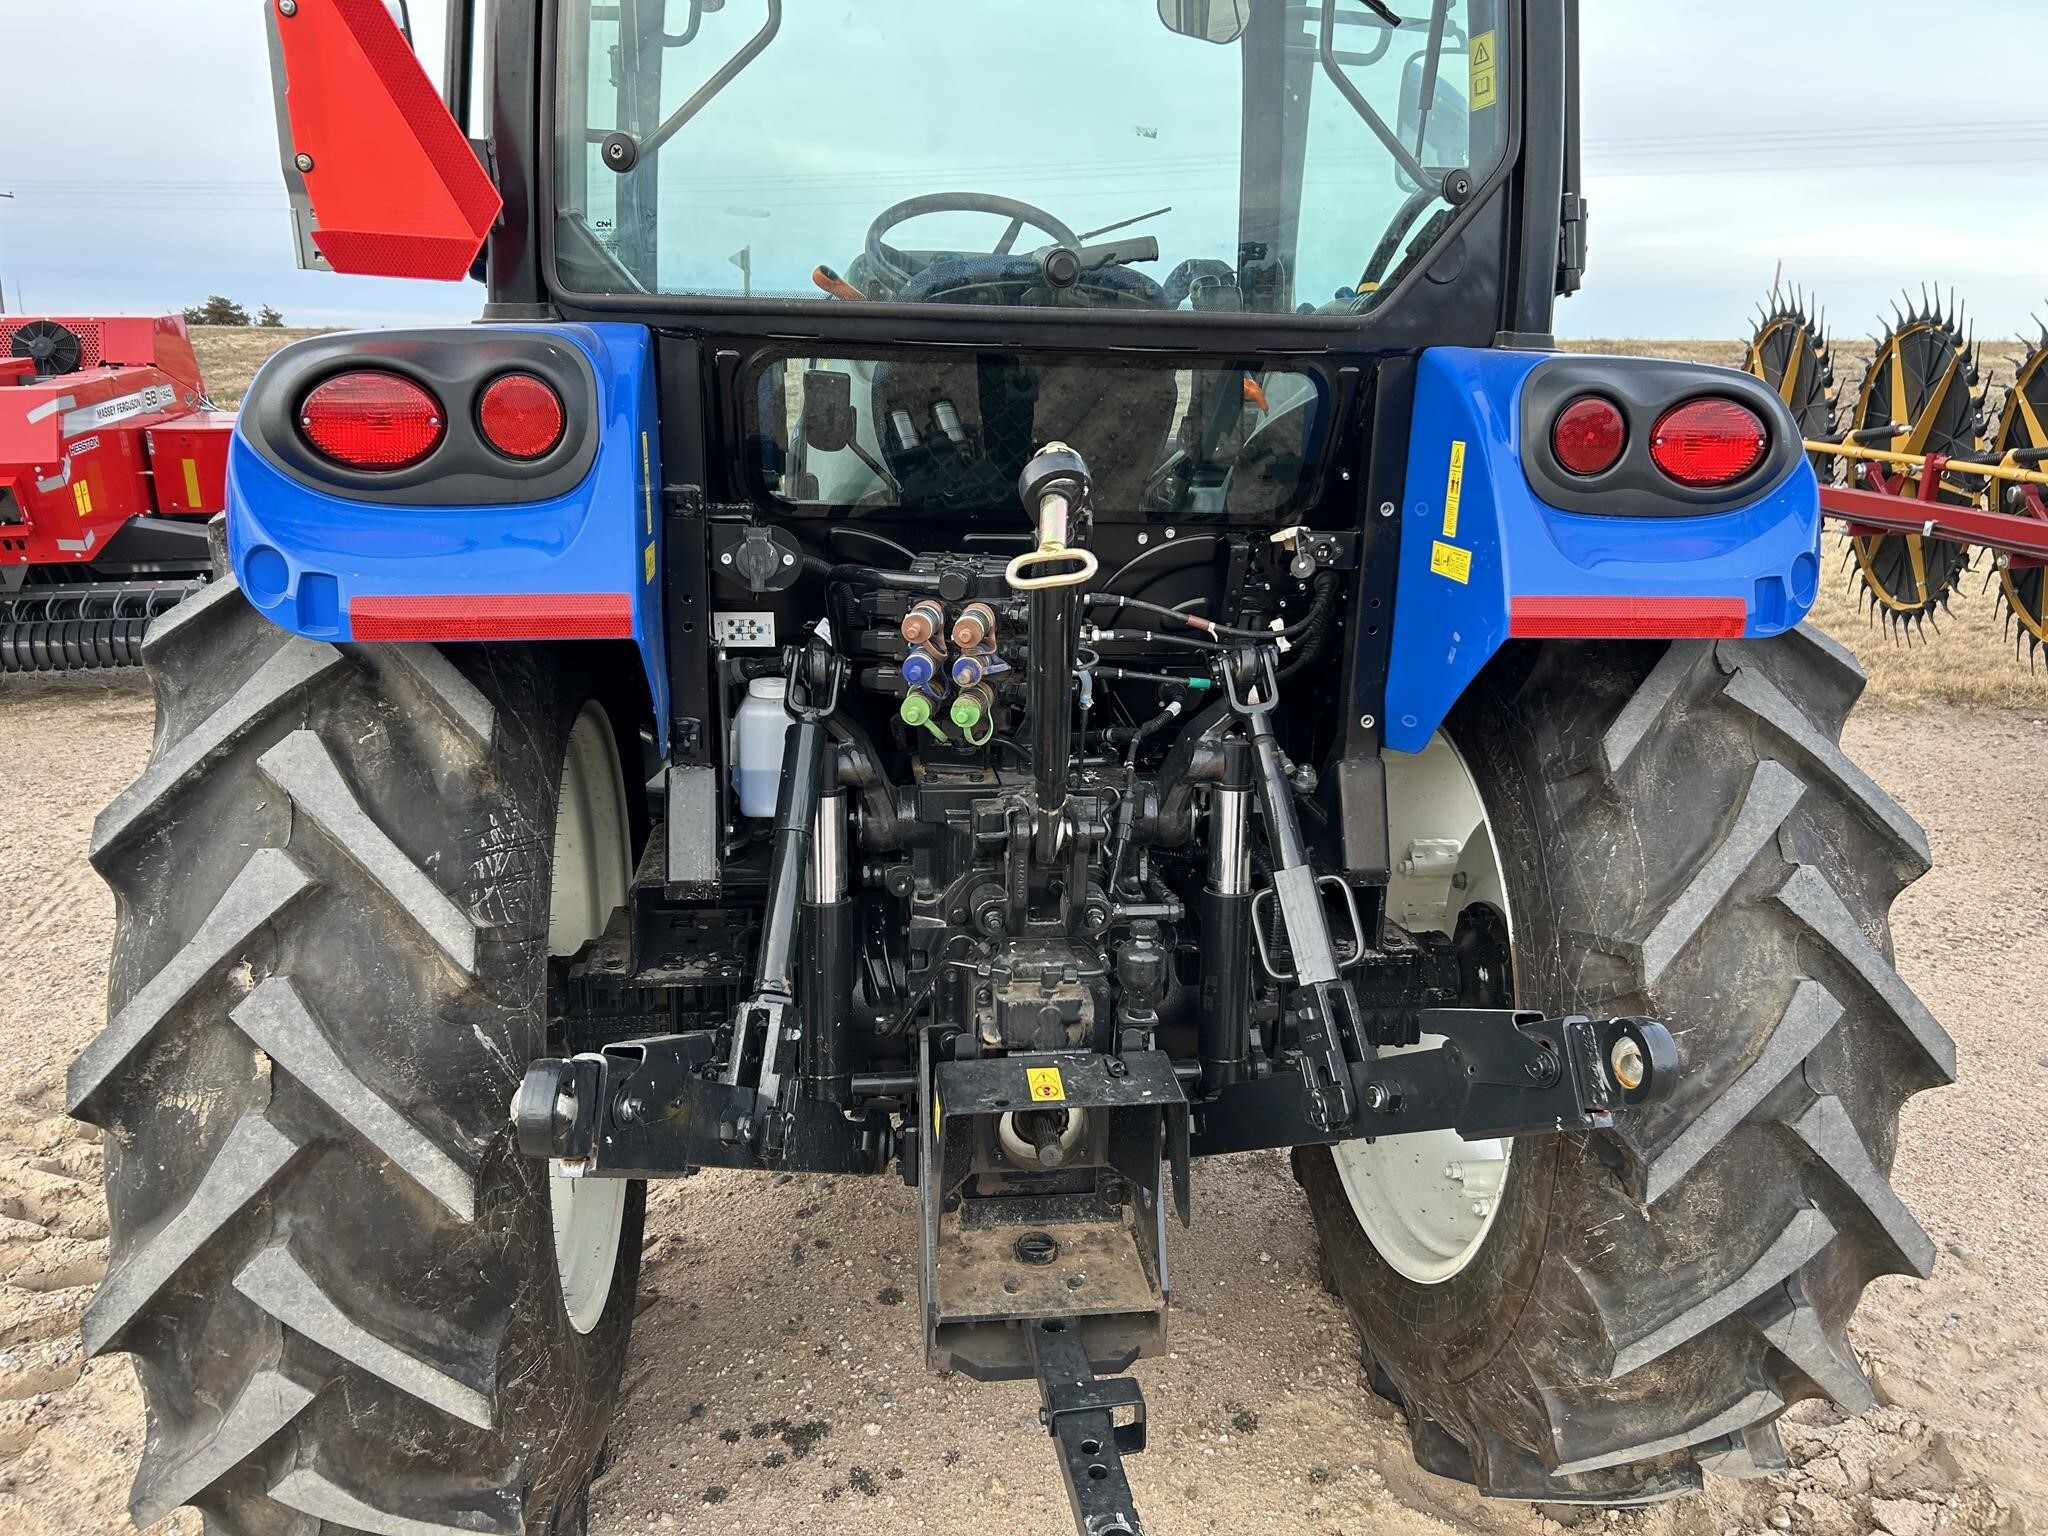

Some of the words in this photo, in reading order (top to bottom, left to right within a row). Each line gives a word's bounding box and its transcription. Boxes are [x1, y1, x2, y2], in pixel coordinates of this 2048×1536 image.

[96, 404, 117, 419] MASSEY
[117, 398, 142, 414] FERGUSON
[144, 390, 158, 407] SB
[70, 437, 99, 455] HESSTON
